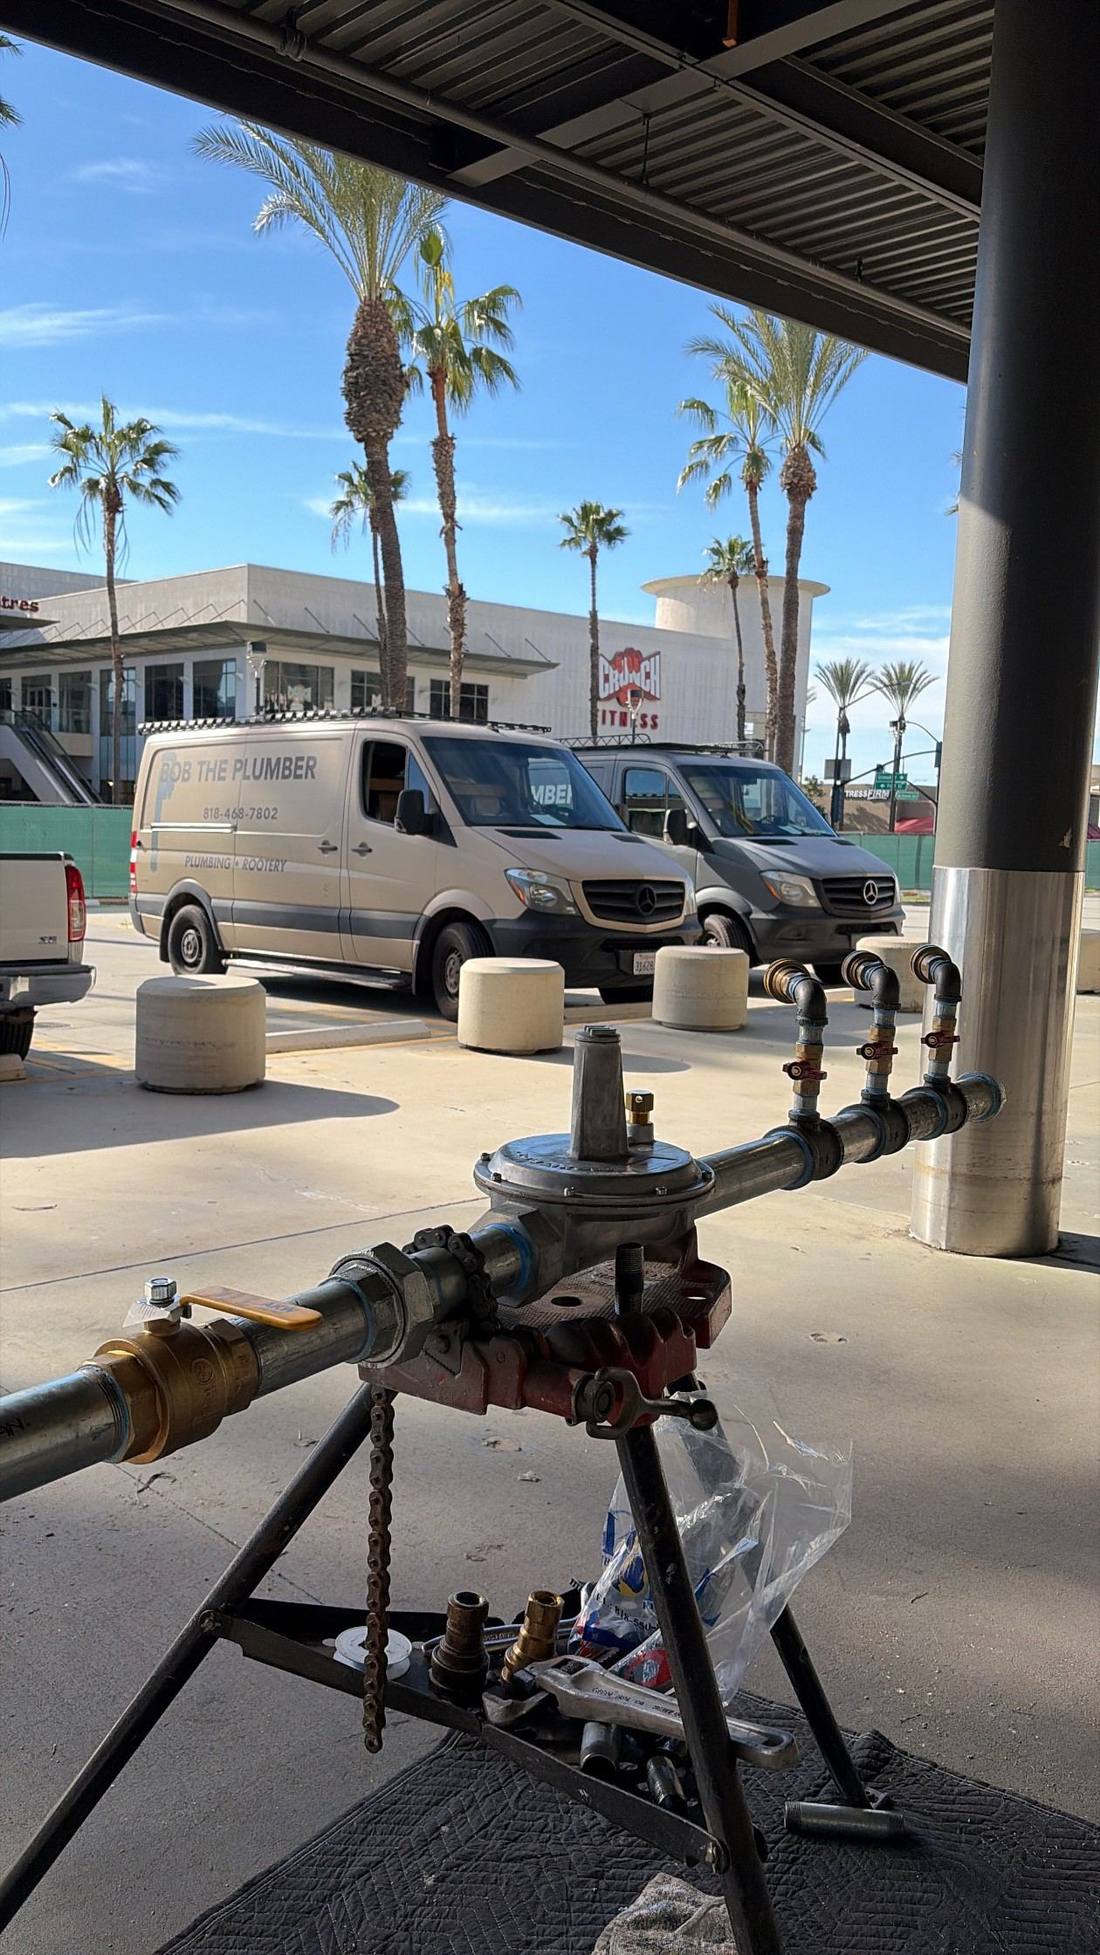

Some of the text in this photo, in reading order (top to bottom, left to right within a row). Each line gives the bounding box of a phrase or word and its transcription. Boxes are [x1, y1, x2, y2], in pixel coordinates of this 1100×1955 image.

[0, 596, 39, 612] tres
[599, 654, 661, 700] CRUNCH
[602, 709, 659, 730] ITNSS
[160, 755, 317, 782] BOB THE PLUMBER
[203, 807, 278, 819] 818-468-7802
[185, 855, 231, 870] PLUMBING
